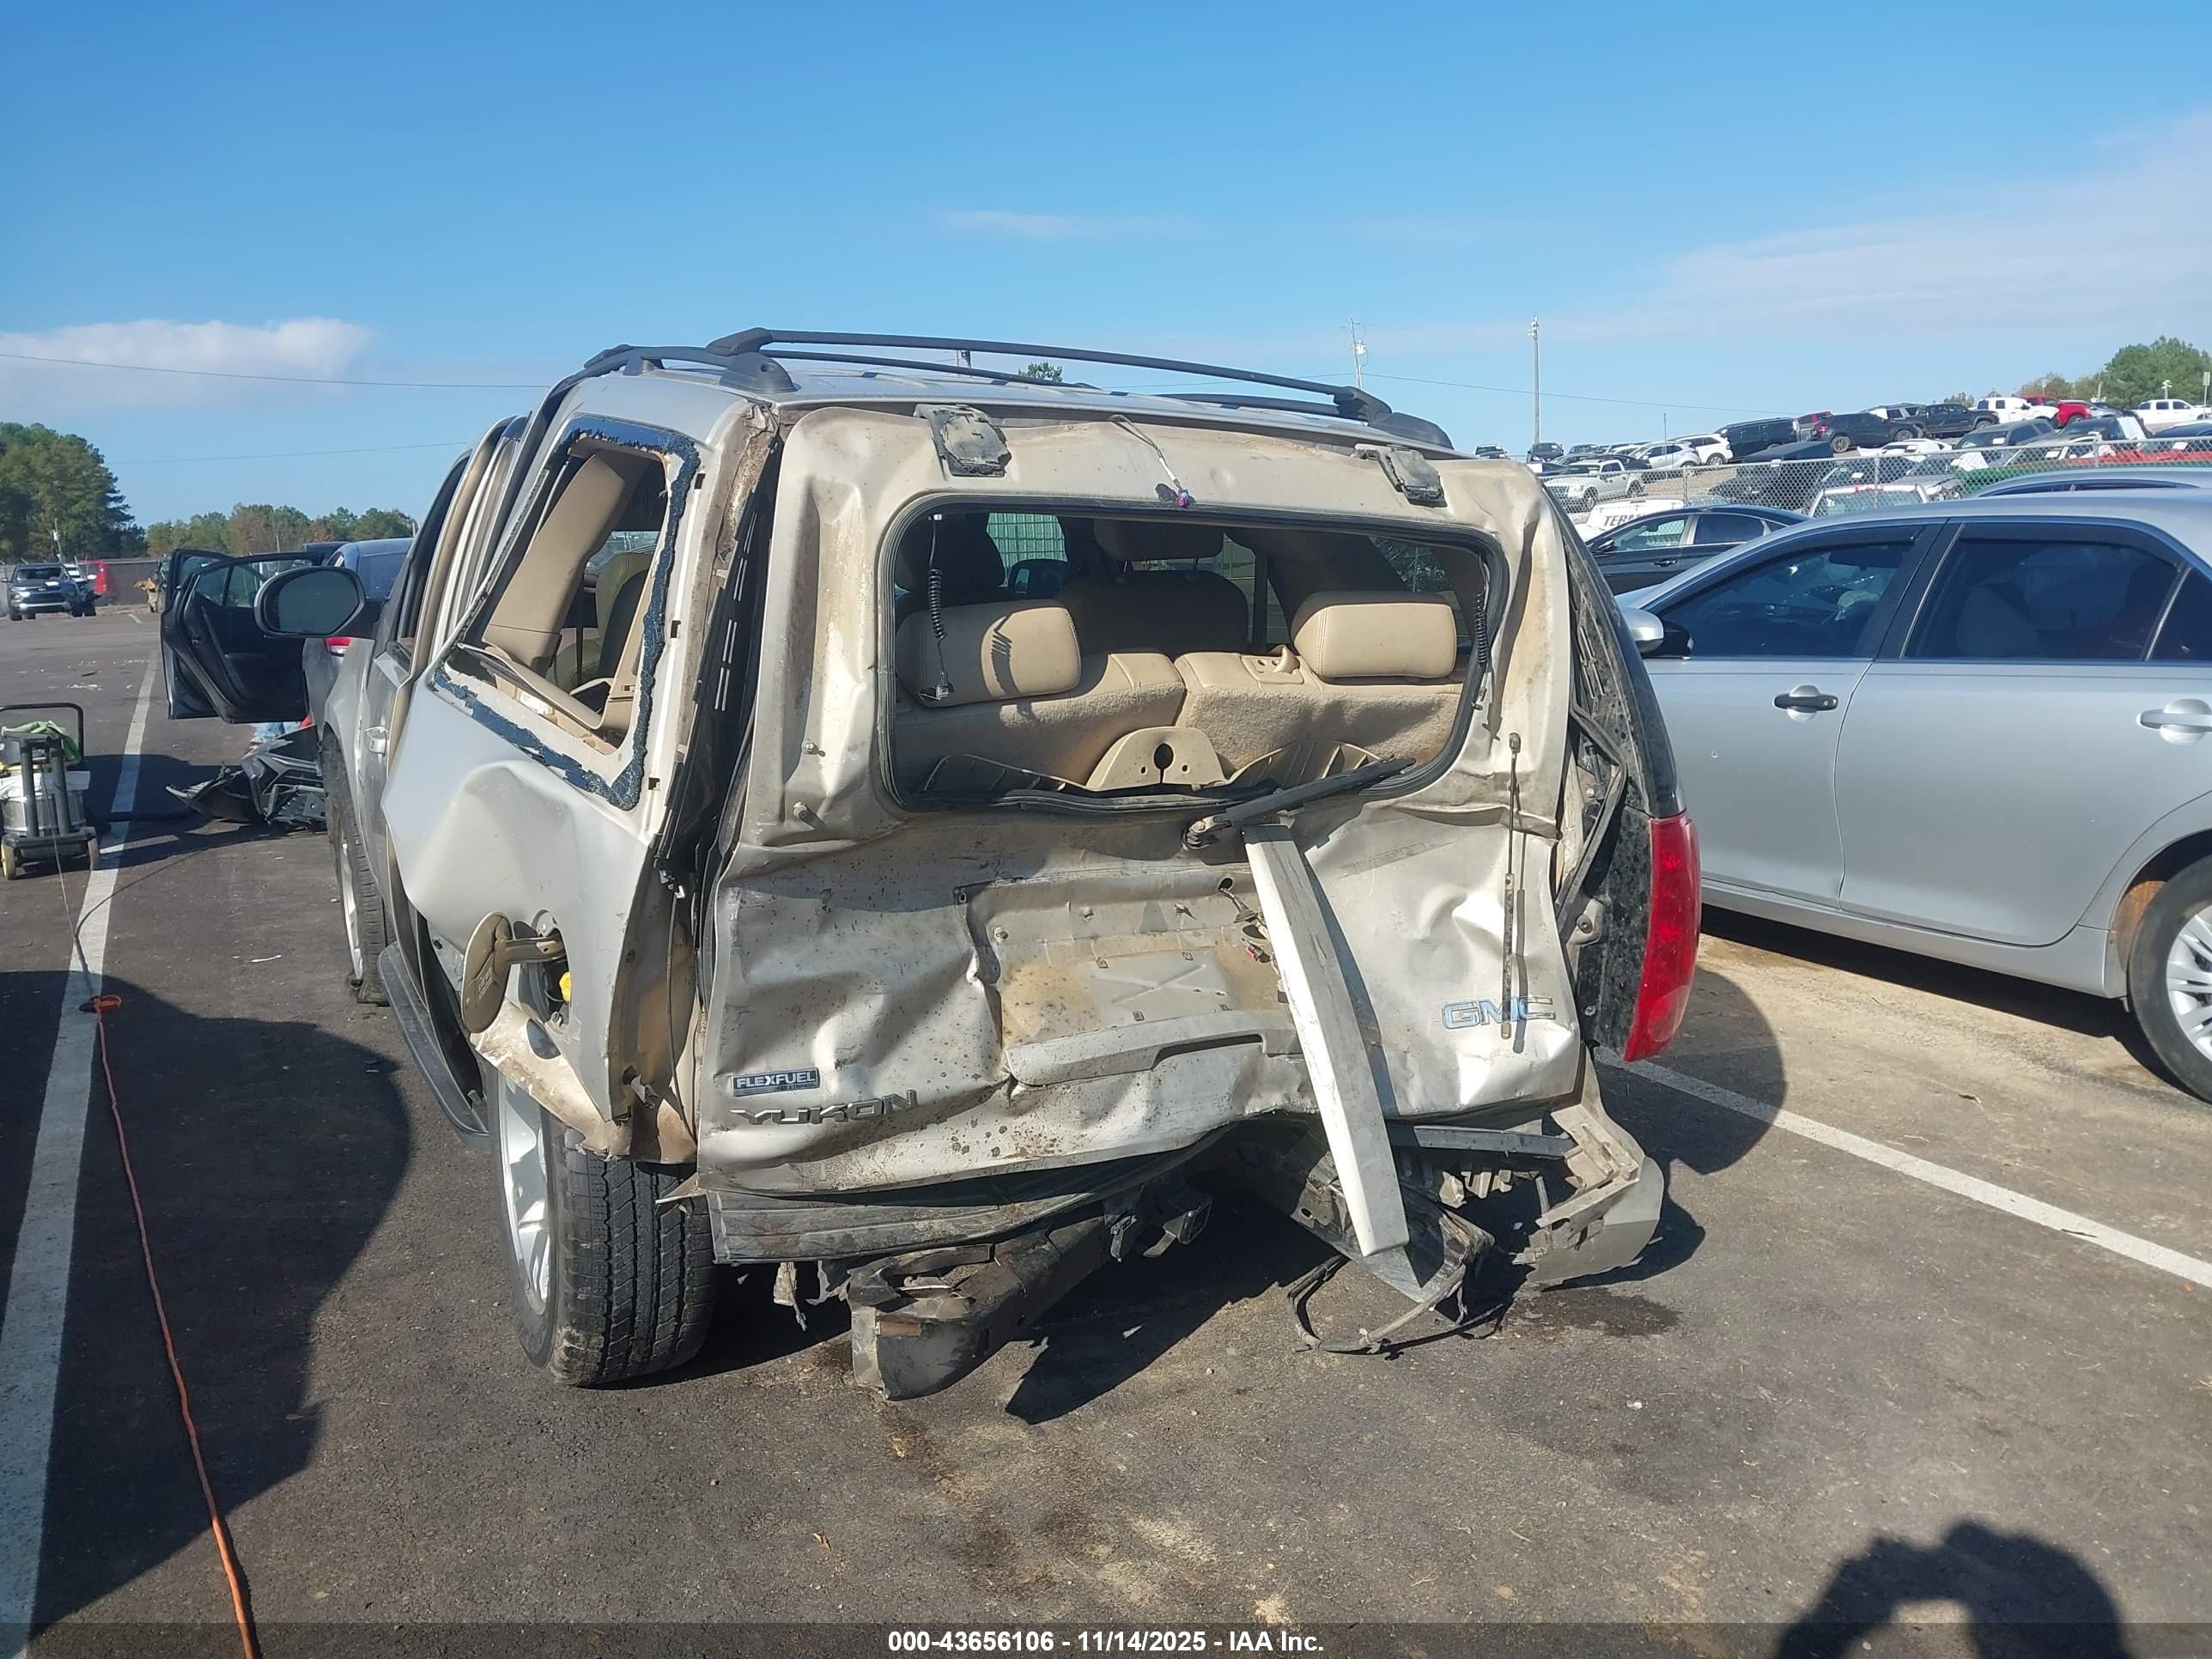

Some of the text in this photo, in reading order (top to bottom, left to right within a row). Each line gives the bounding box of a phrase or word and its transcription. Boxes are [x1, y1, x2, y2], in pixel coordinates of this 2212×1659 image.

[1442, 996, 1556, 1029] GMC
[736, 1071, 816, 1088] FLEXFUEL
[730, 1090, 918, 1125] YUKON
